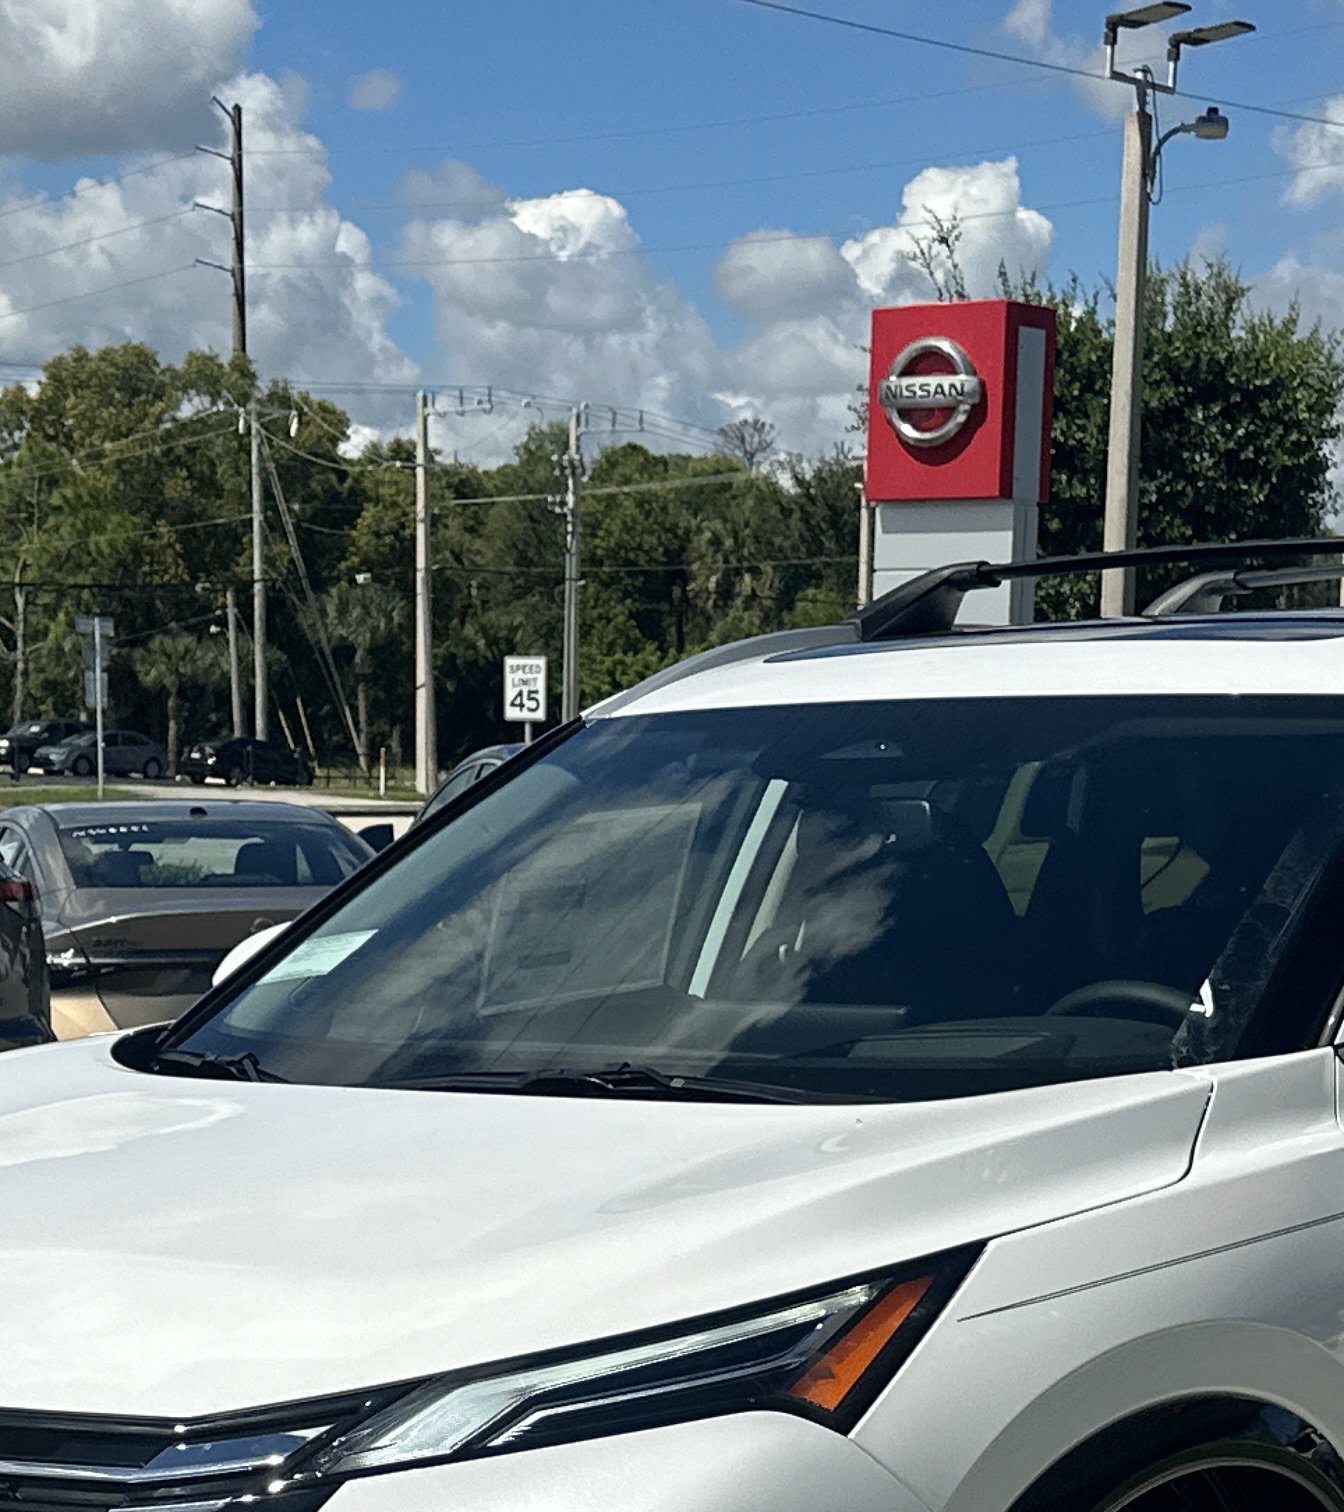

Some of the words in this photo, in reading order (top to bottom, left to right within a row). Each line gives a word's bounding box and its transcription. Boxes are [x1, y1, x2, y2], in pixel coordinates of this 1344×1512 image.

[885, 382, 965, 400] NISSAN
[508, 663, 542, 674] SPEED
[512, 677, 538, 688] LIMIT
[509, 689, 541, 713] 45
